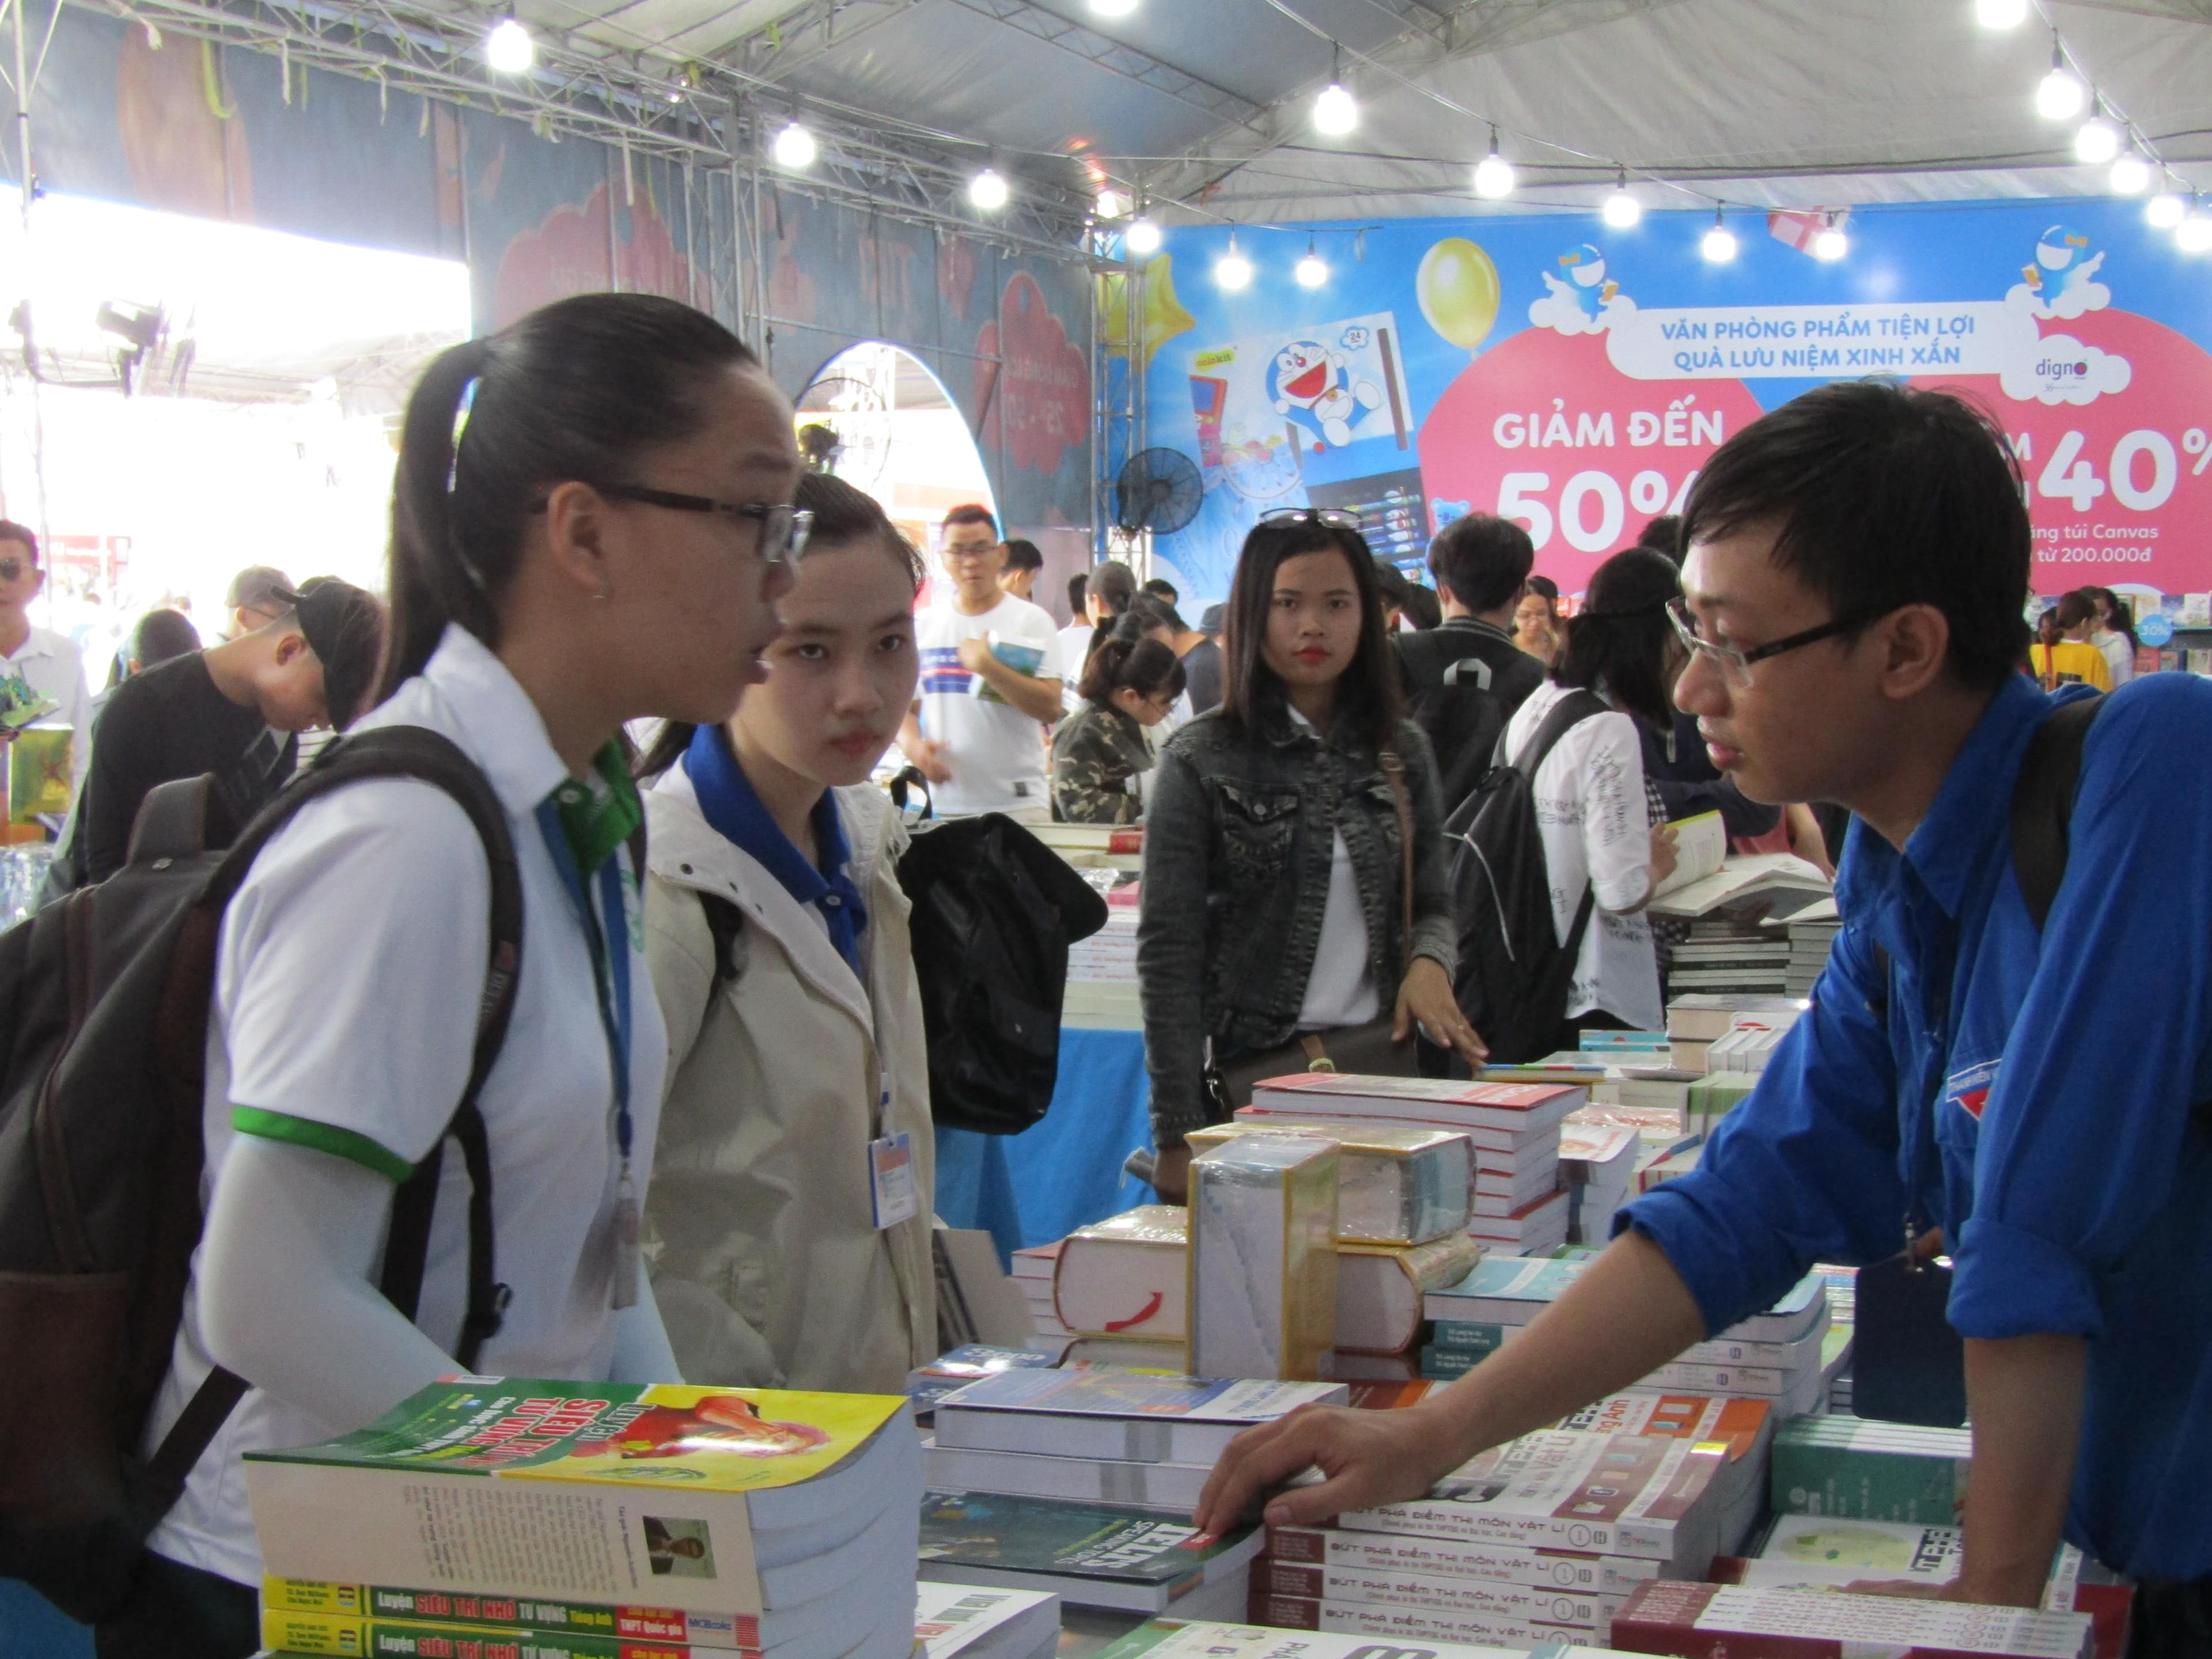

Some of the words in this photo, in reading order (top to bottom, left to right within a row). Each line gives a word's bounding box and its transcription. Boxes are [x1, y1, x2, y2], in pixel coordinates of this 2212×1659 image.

[1661, 319, 1707, 340] VĂN
[1714, 316, 1797, 339] PHÒNG
[1804, 312, 1871, 338] PHẨM
[1877, 313, 1929, 340] TIỆN
[1937, 315, 1974, 337] LỢI
[1674, 347, 1723, 372] QUÀ
[1730, 347, 1774, 367] LƯU
[1782, 344, 1840, 371] NIỆM
[1846, 347, 1903, 366] XINH
[1912, 338, 1960, 365] XẮN
[1493, 398, 1615, 448] GIẢM
[1627, 394, 1723, 446] ĐẾN
[2064, 524, 2087, 538] túi
[2093, 524, 2158, 539] Canvas
[2037, 547, 2057, 562] từ
[2061, 548, 2152, 563] 200.000đ
[528, 1399, 610, 1436] SIÊU
[415, 1592, 450, 1615] SIÊU
[454, 1596, 480, 1618] TRÍ
[418, 1636, 453, 1658] SIÊU
